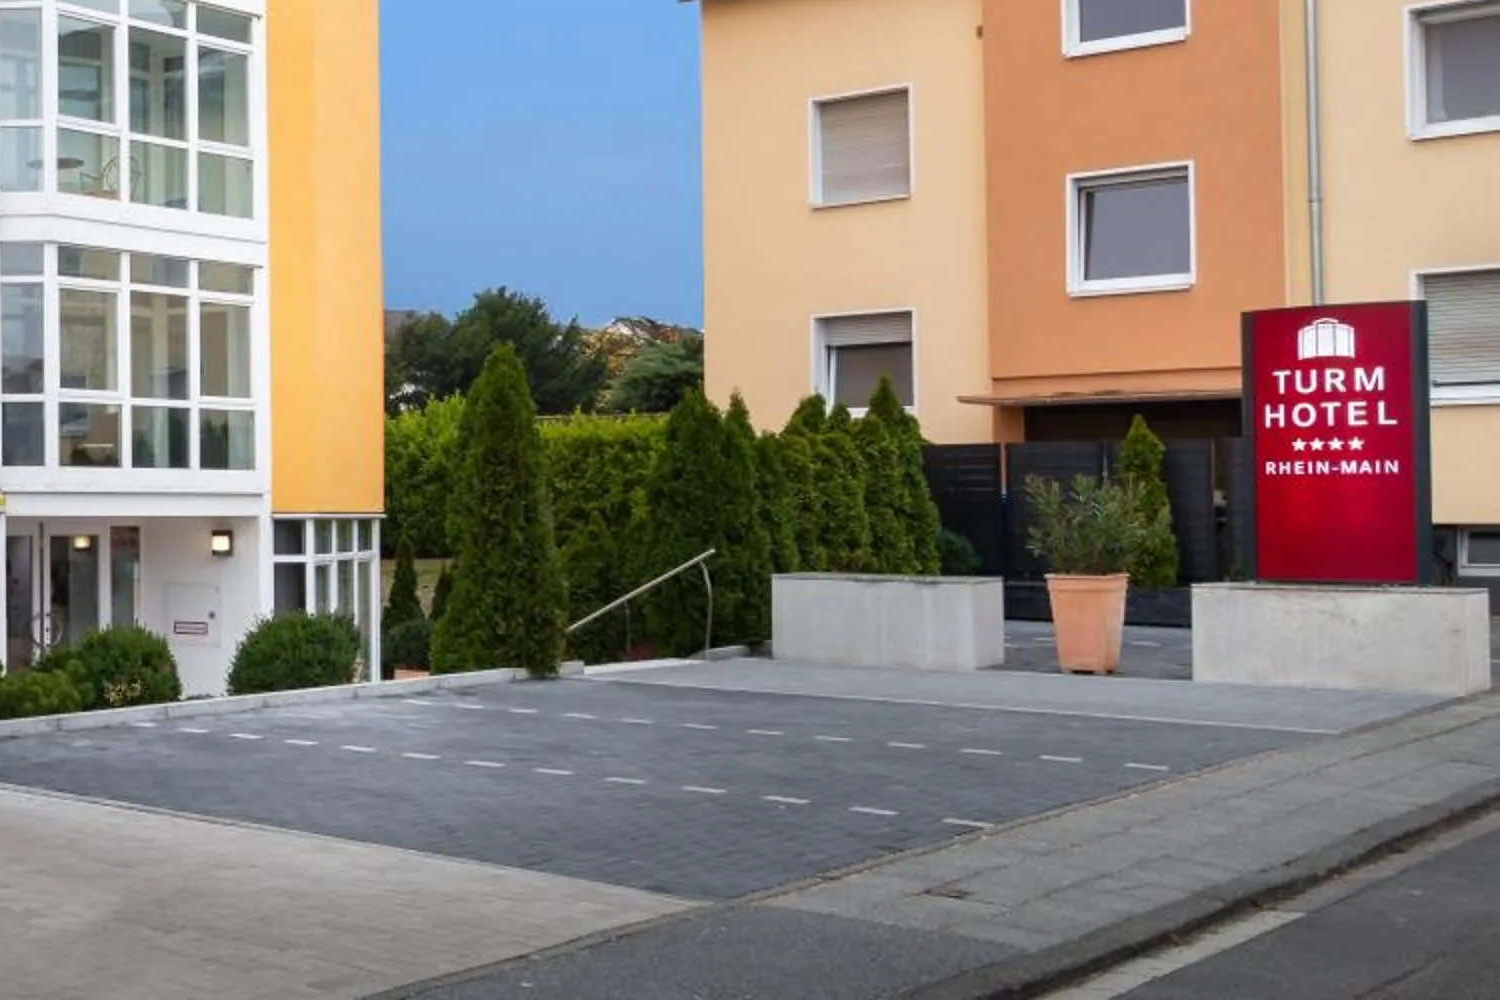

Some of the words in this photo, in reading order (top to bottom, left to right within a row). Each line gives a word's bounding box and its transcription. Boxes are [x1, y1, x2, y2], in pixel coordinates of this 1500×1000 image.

[1272, 366, 1385, 395] TURM
[1264, 400, 1399, 428] HOTEL
[1265, 459, 1400, 475] RHEIN-MAIN
